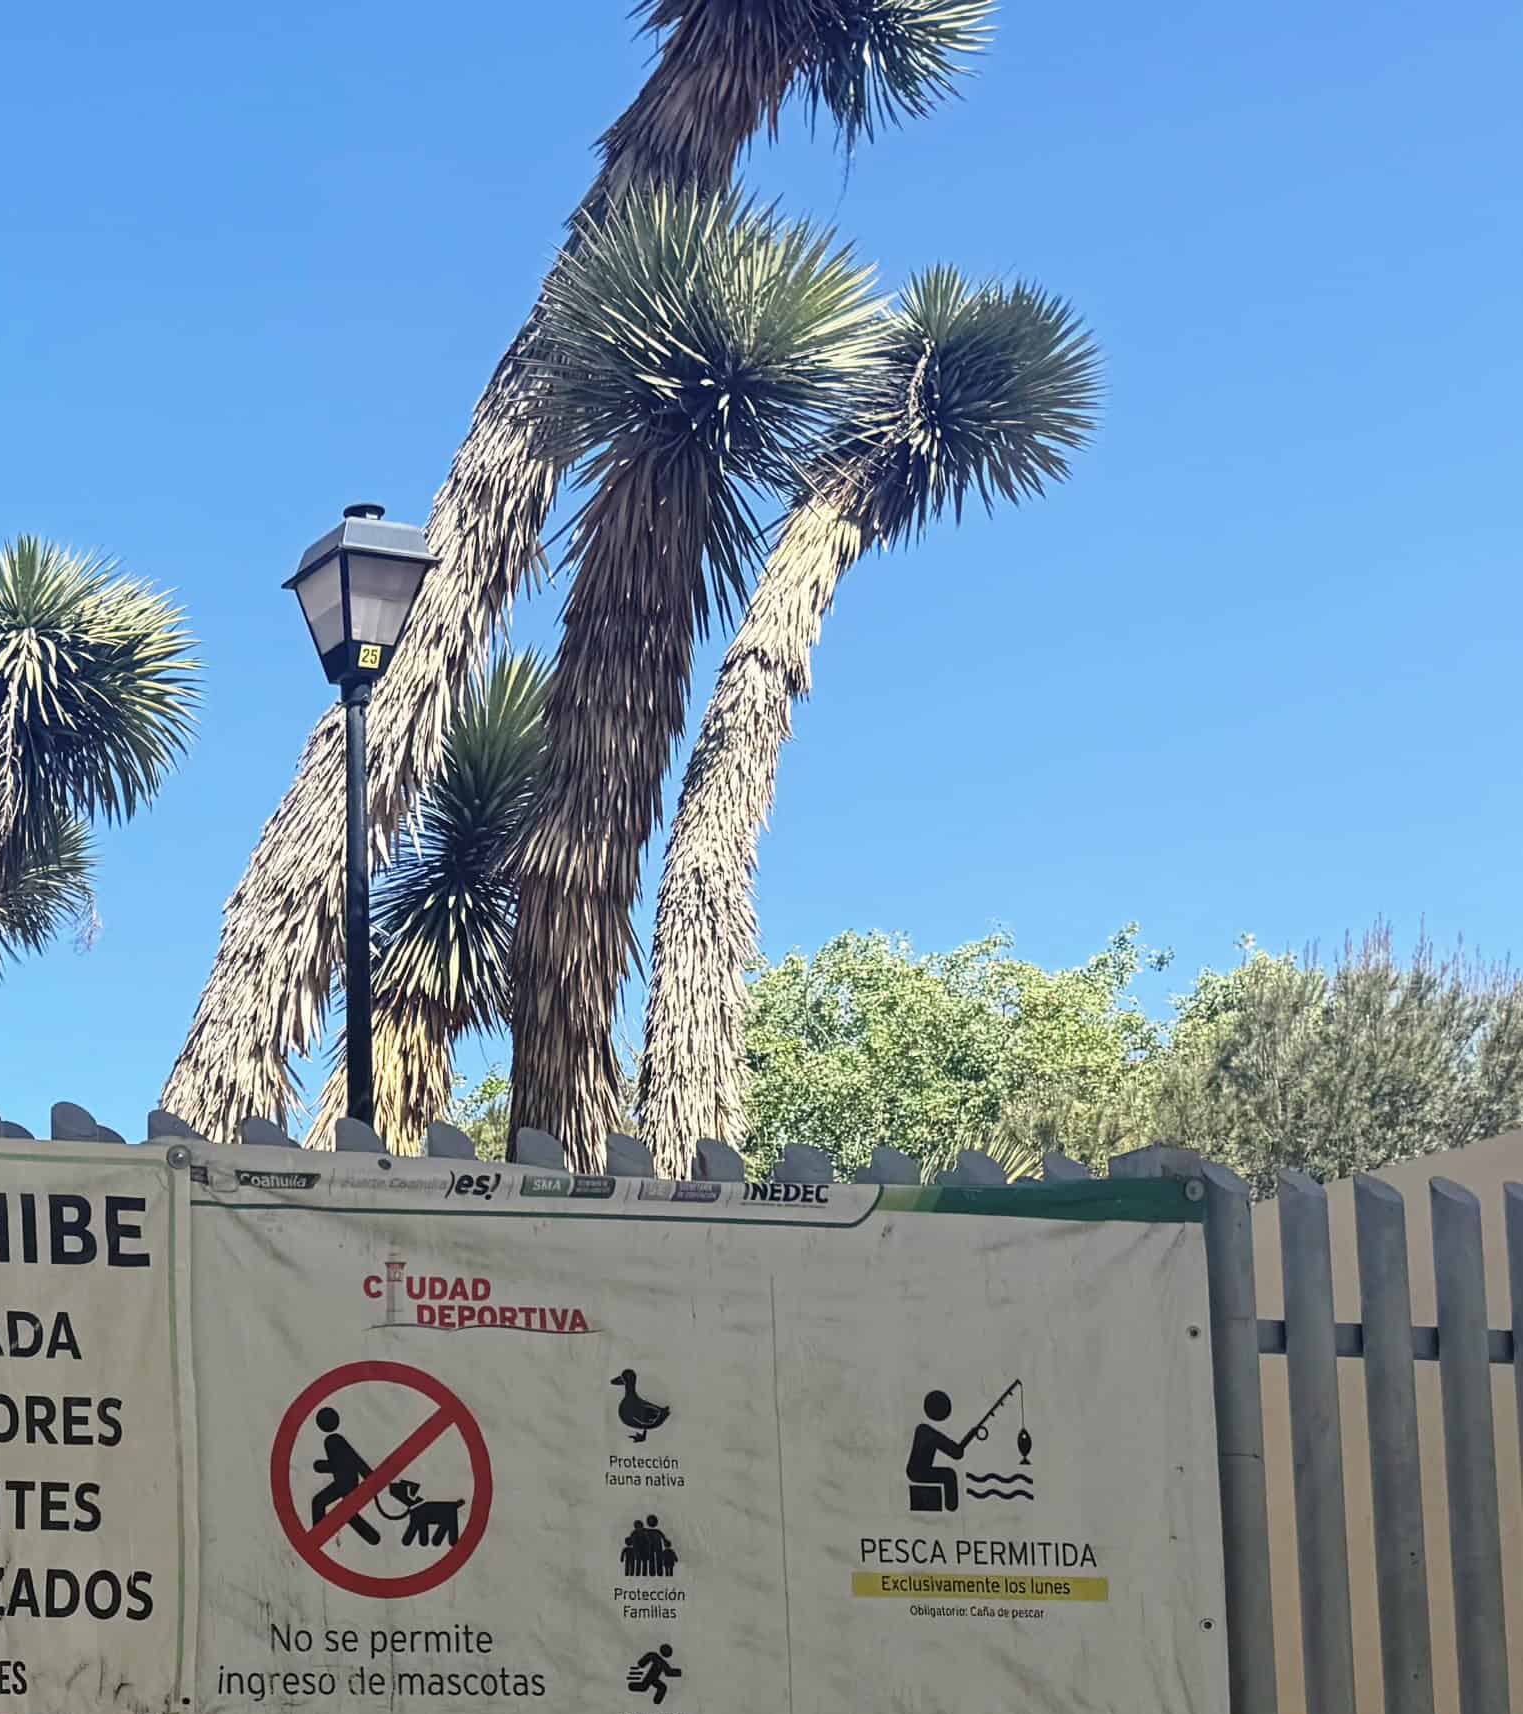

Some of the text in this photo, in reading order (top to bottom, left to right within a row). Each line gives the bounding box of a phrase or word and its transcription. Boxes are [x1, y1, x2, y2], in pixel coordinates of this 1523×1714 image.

[532, 1179, 562, 1192] SMA
[417, 1304, 589, 1331] DEPORTIVA
[609, 1455, 679, 1469] Protección
[605, 1472, 684, 1487] fauna nativa
[861, 1539, 1097, 1567] PESCA PERMITIDA
[882, 1576, 1071, 1595] Exclusivamente los lunes
[614, 1587, 685, 1601] Protección
[623, 1605, 677, 1619] Familias
[910, 1605, 1044, 1620] Obligatorio: Caña de pescar
[270, 1623, 493, 1661] No se permite
[218, 1666, 545, 1702] ingreso de mascotas
